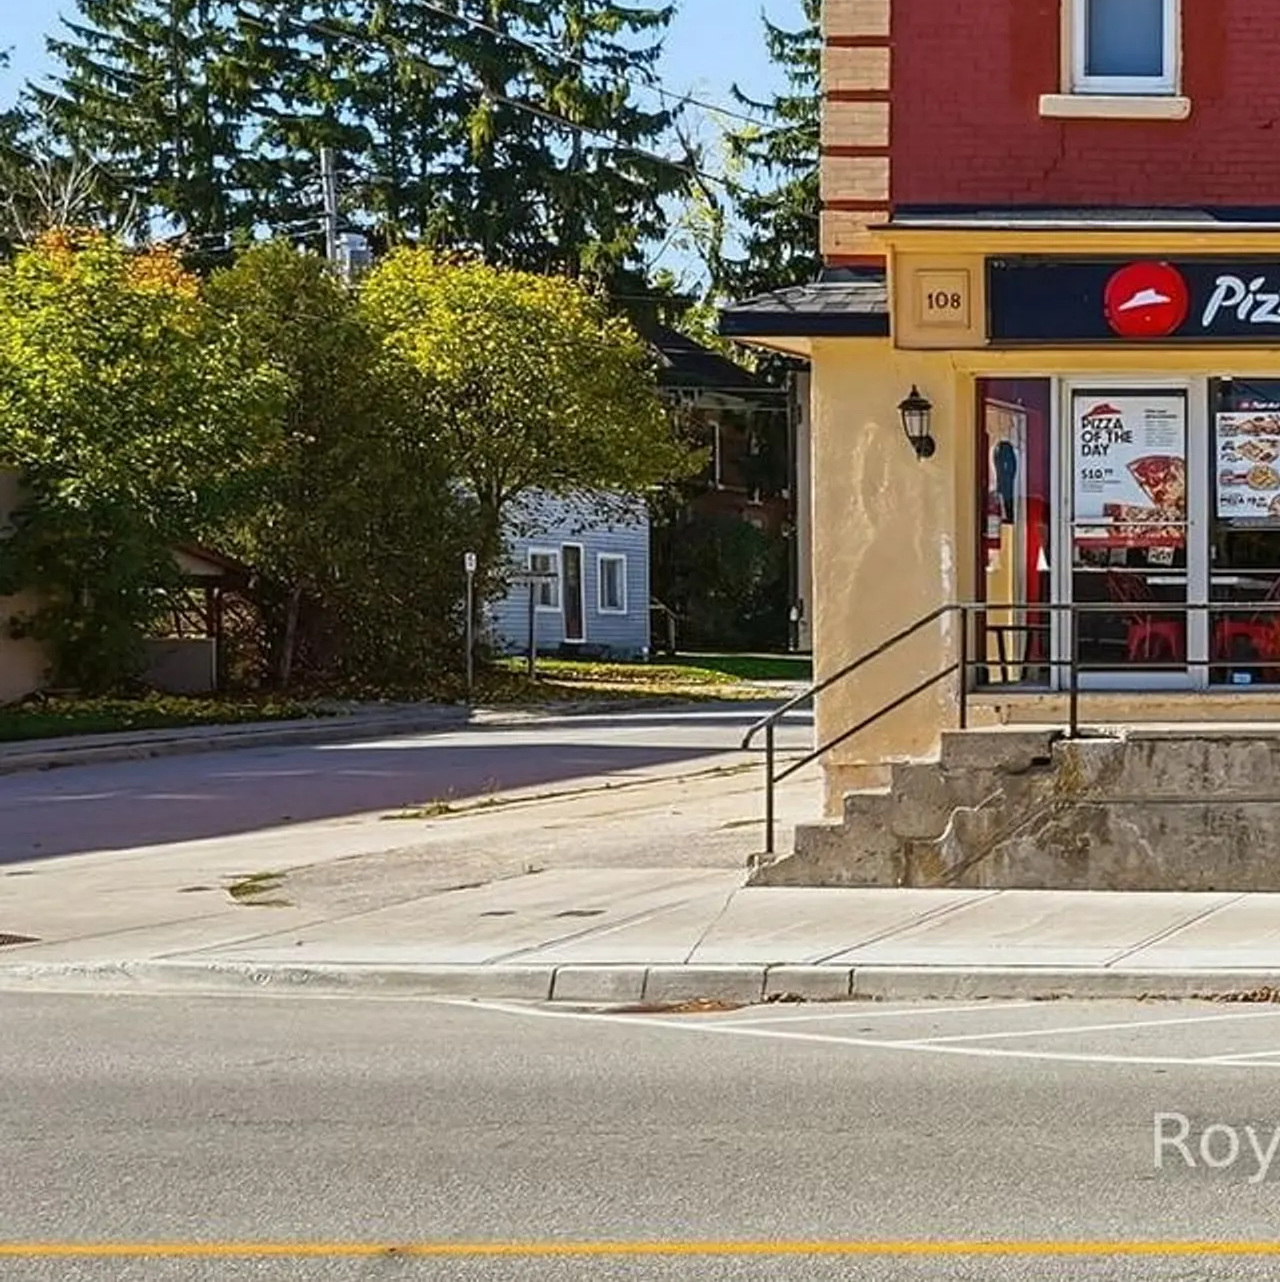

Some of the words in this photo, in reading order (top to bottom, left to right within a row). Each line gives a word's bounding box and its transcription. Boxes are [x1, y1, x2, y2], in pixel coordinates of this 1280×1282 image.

[926, 291, 961, 310] 108
[1081, 416, 1123, 430] PIZZA
[1081, 430, 1102, 444] OF
[1106, 430, 1133, 444] THE
[1081, 443, 1109, 457] DAY
